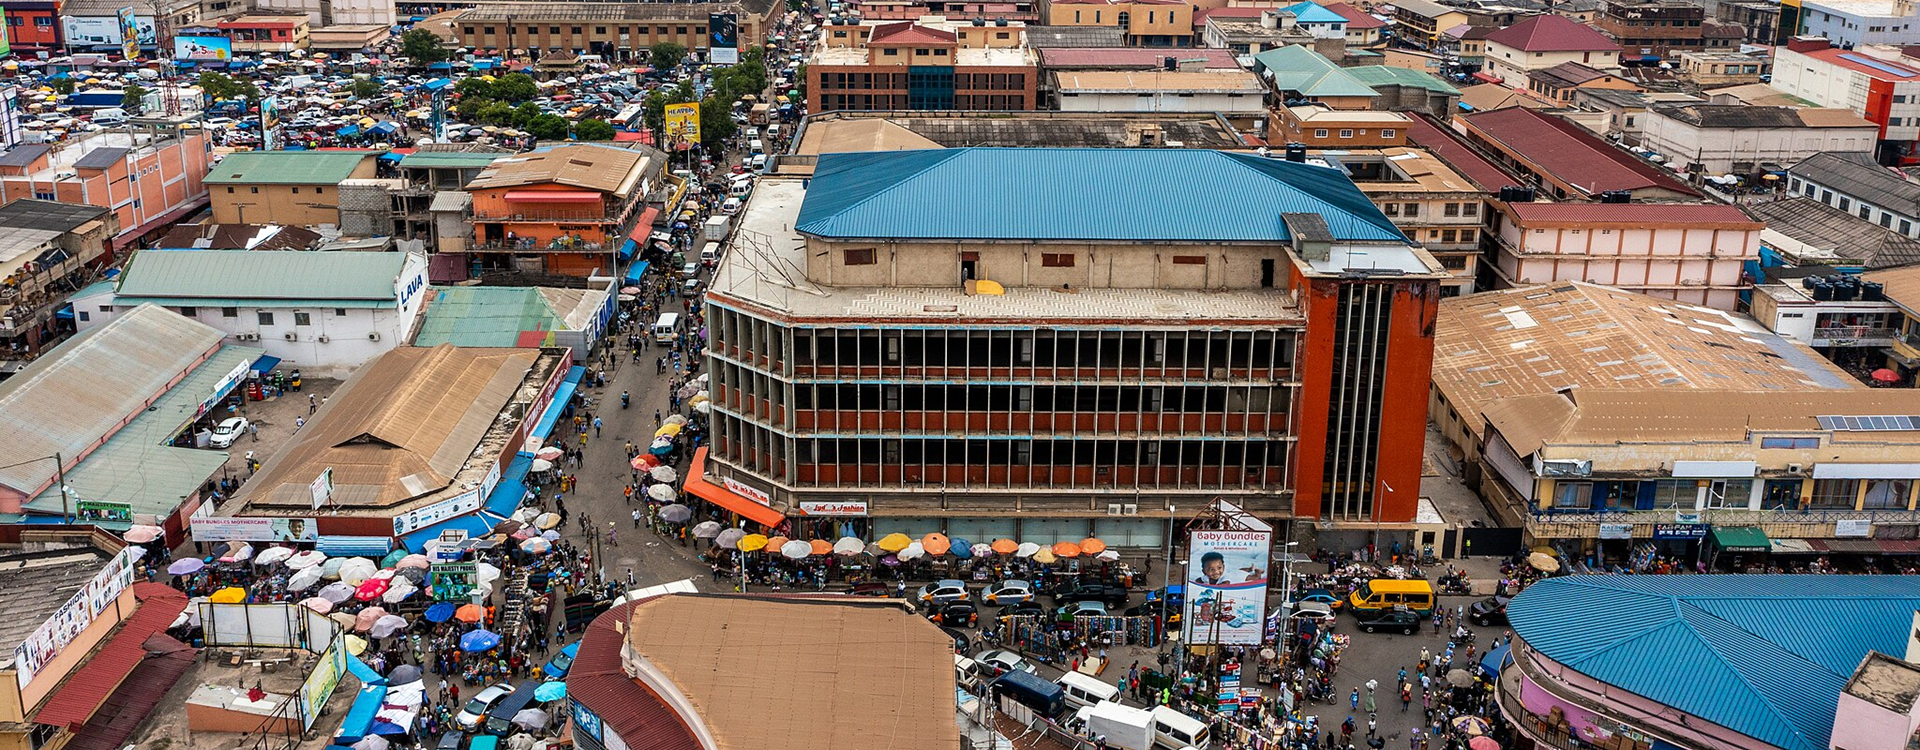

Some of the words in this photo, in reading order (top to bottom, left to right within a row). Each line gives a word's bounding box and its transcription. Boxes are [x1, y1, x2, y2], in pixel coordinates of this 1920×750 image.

[401, 273, 423, 305] LAVA
[1197, 532, 1221, 541] Baby
[1224, 532, 1266, 540] Bundles
[54, 589, 85, 622] FASHION
